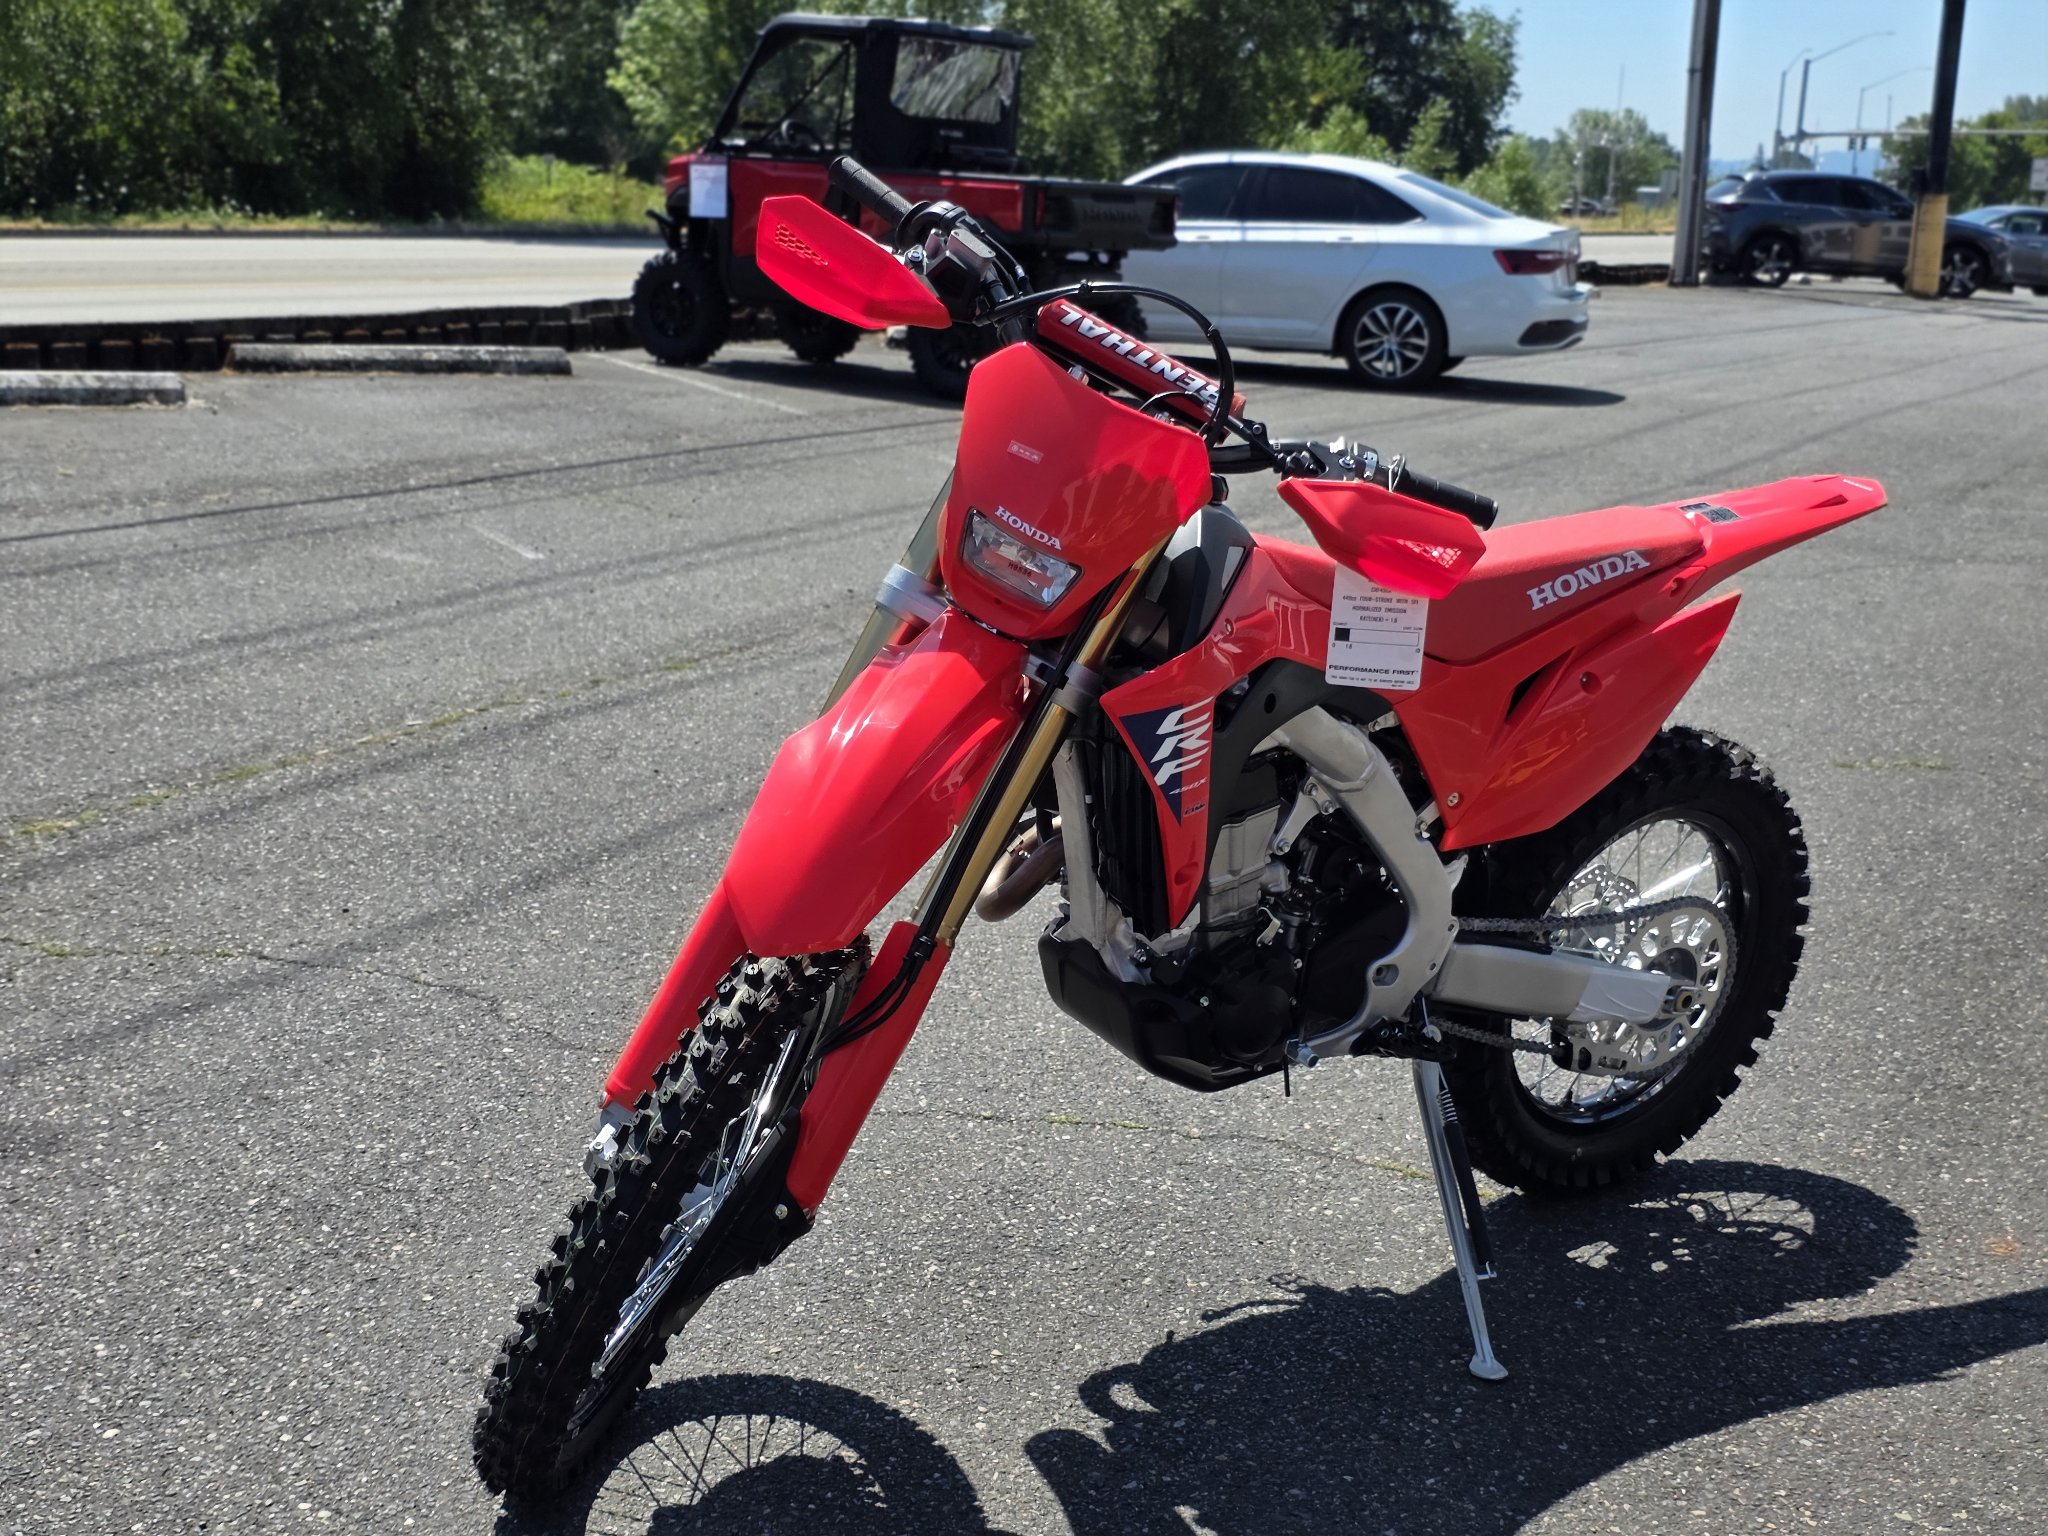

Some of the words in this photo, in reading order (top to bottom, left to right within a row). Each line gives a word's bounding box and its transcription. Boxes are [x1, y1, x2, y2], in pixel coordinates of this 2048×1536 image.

[1059, 304, 1220, 405] RENTHAL
[995, 506, 1062, 550] HONDA
[1526, 550, 1650, 611] HONDA
[1328, 664, 1390, 674] PERFORMANCE
[1150, 695, 1215, 787] CRF
